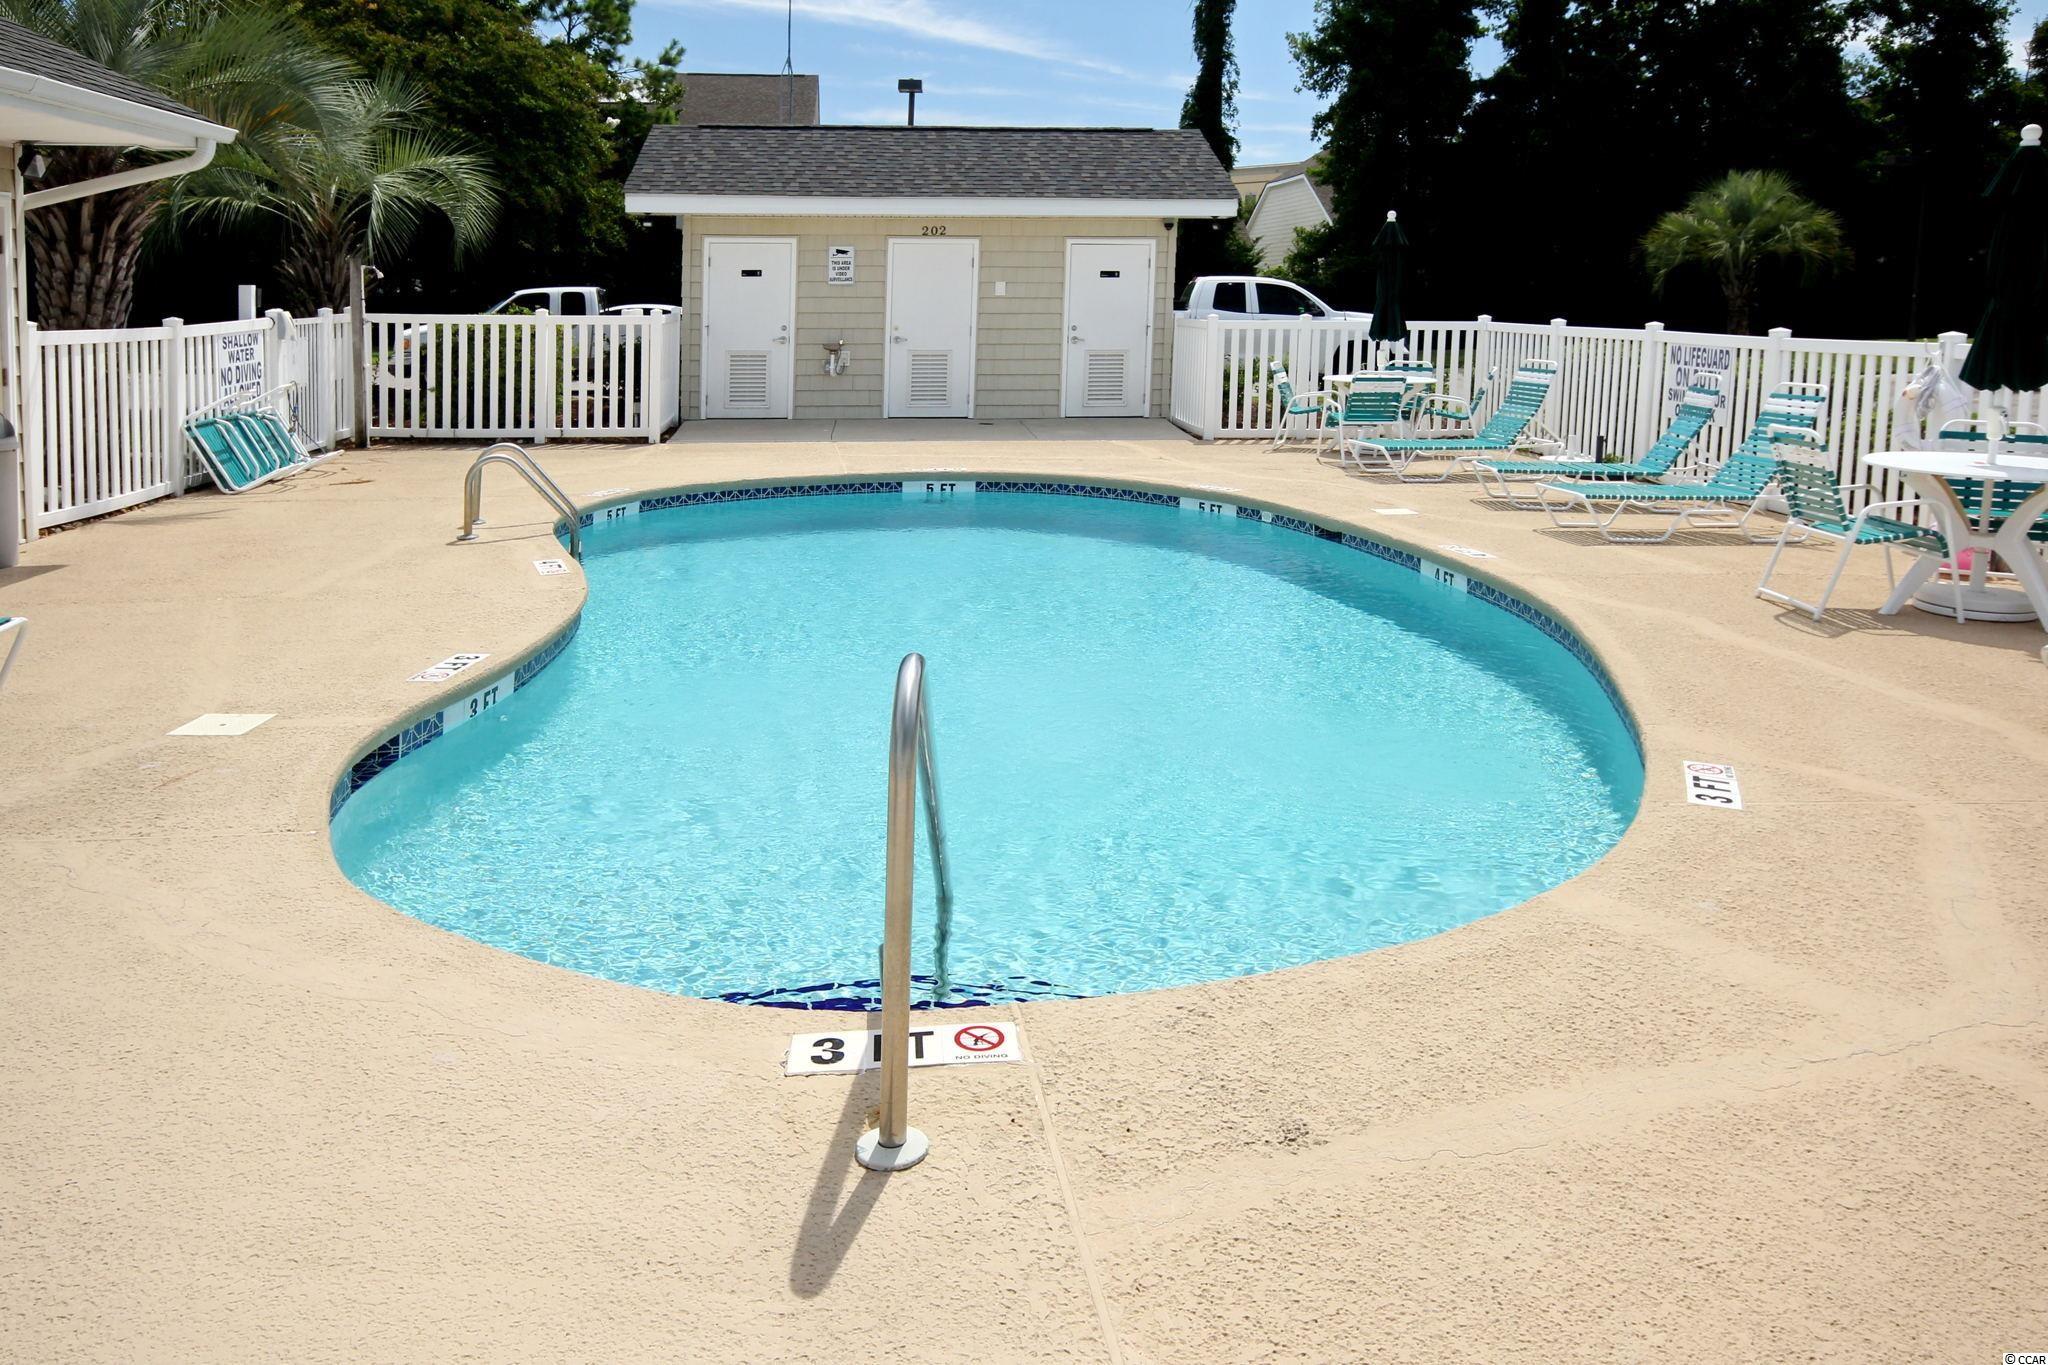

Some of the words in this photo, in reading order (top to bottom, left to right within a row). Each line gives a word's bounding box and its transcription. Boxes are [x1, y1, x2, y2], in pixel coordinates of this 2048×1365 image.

[922, 226, 946, 236] 202
[222, 333, 258, 349] SHALLOW
[228, 348, 254, 363] WATER
[1670, 345, 1682, 365] NO
[1684, 346, 1730, 370] LIFEGUARD
[221, 367, 232, 386] NO
[235, 361, 262, 383] DIVING
[1676, 367, 1689, 387] ON
[926, 483, 934, 492] 5
[940, 483, 956, 492] FT
[607, 510, 612, 520] 5
[616, 506, 626, 518] FT
[1199, 502, 1205, 511] 5
[1210, 504, 1222, 513] FT
[1443, 571, 1454, 586] FT
[470, 698, 478, 718] 3
[484, 686, 498, 710] FT
[1692, 775, 1731, 792] FT
[1695, 794, 1733, 803] 3
[810, 1037, 845, 1065] 3
